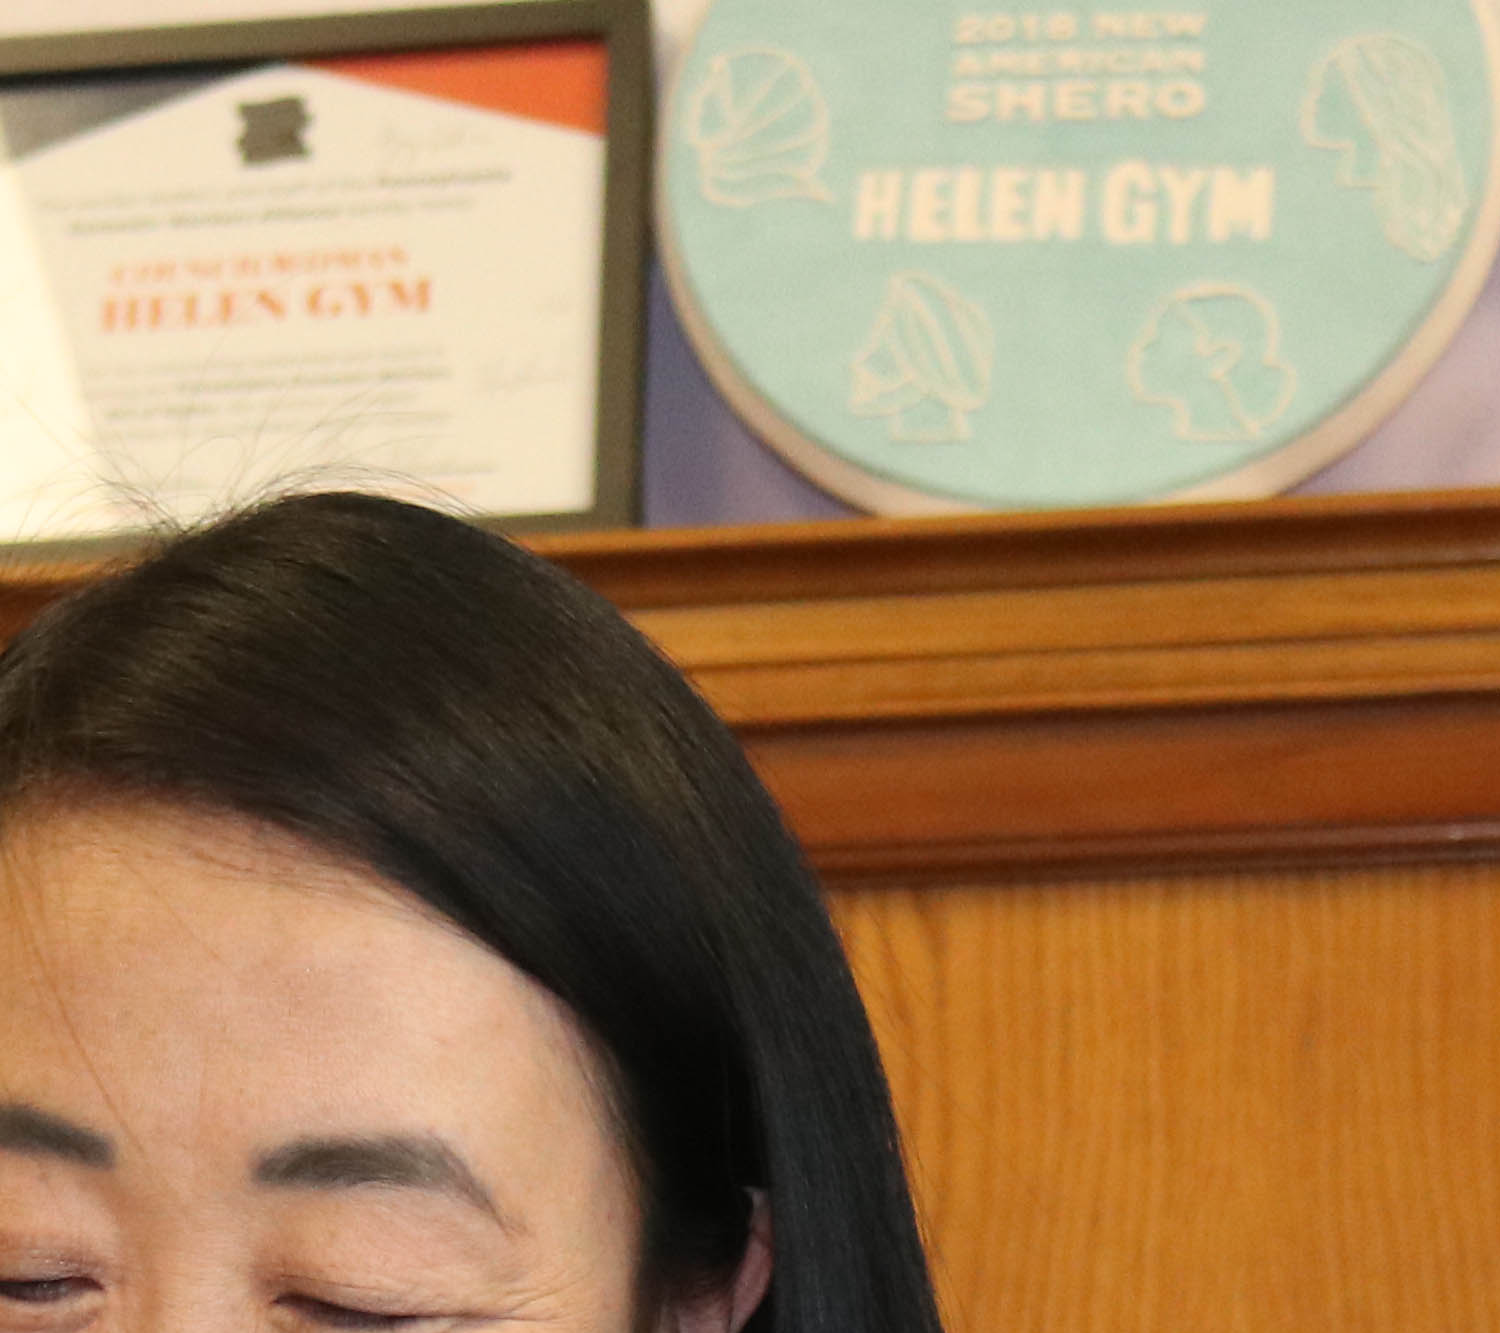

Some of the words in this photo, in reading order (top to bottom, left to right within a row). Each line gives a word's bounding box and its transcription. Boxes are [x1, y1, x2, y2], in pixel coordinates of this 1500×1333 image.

[1092, 12, 1208, 38] NEW
[946, 80, 1206, 122] SHERO
[854, 165, 1086, 242] HELEN
[1102, 160, 1276, 243] GYM
[99, 288, 287, 332] HELEN
[306, 277, 431, 318] GYM
